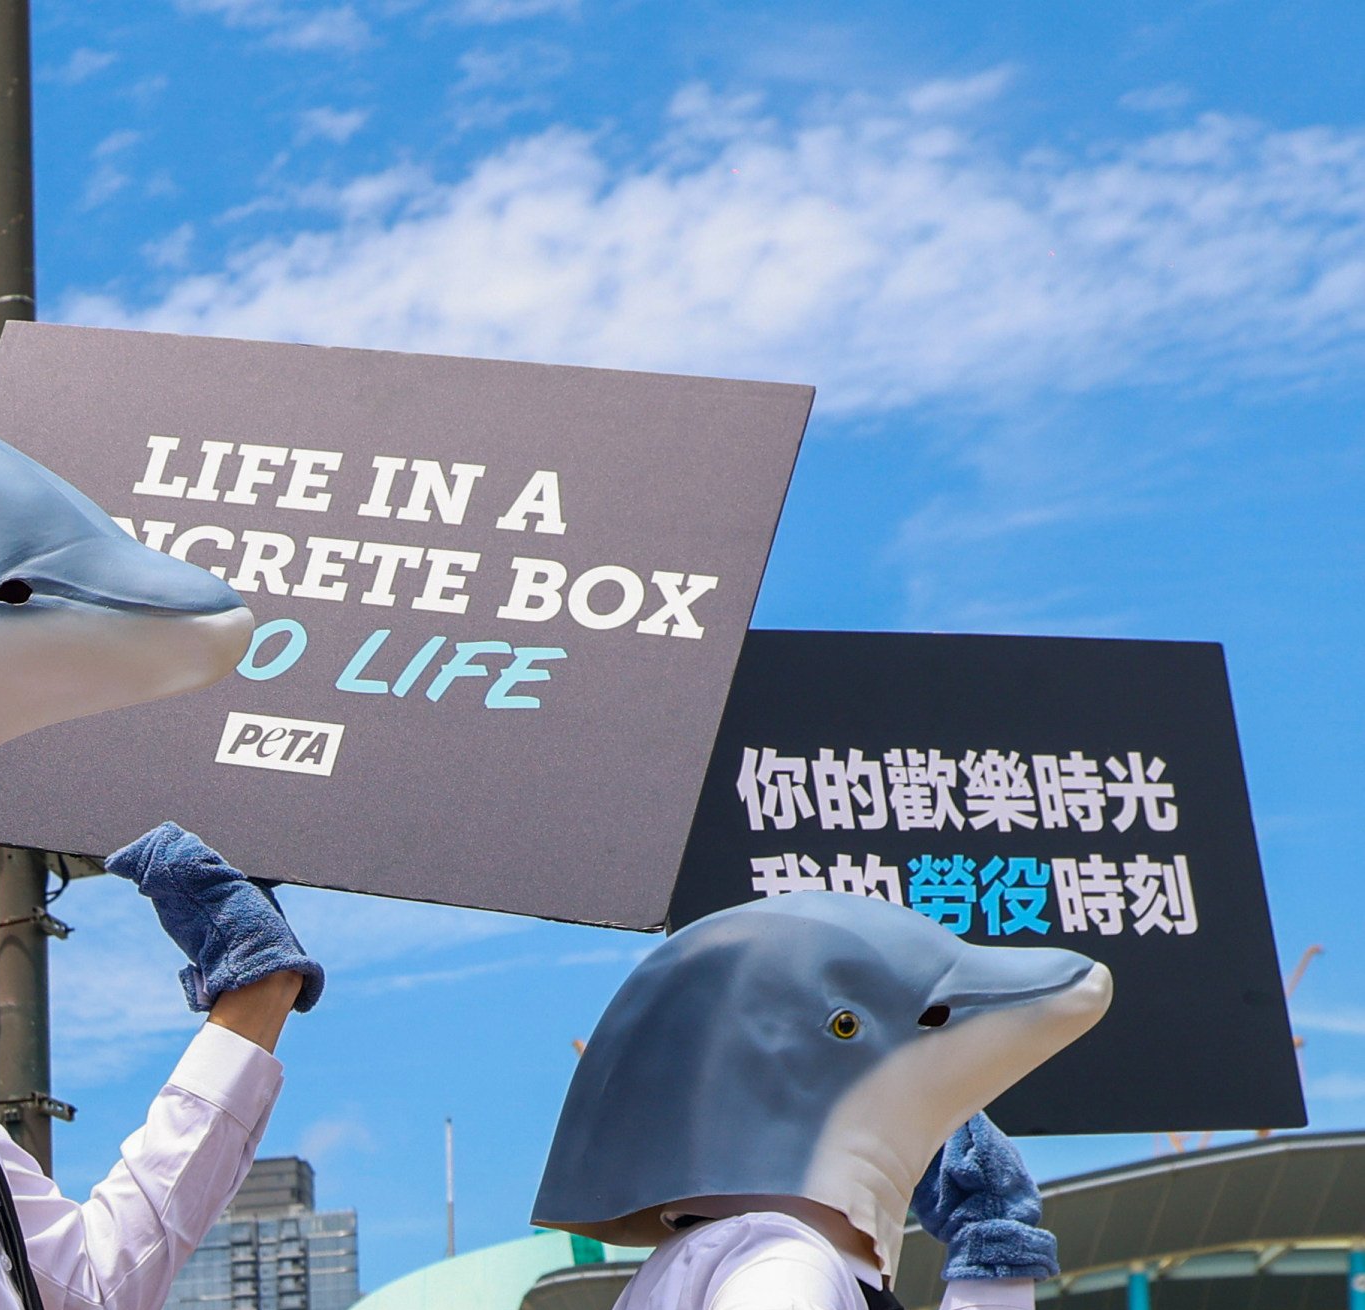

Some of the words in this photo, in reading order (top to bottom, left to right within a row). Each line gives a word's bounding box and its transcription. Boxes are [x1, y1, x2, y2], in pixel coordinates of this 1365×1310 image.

[133, 435, 344, 512] LIFE
[357, 455, 485, 526] IN
[496, 470, 567, 535] A
[497, 556, 718, 640] BOX
[236, 618, 308, 681] O
[335, 629, 568, 709] LIFE
[736, 746, 1179, 833] 你的歡樂時光
